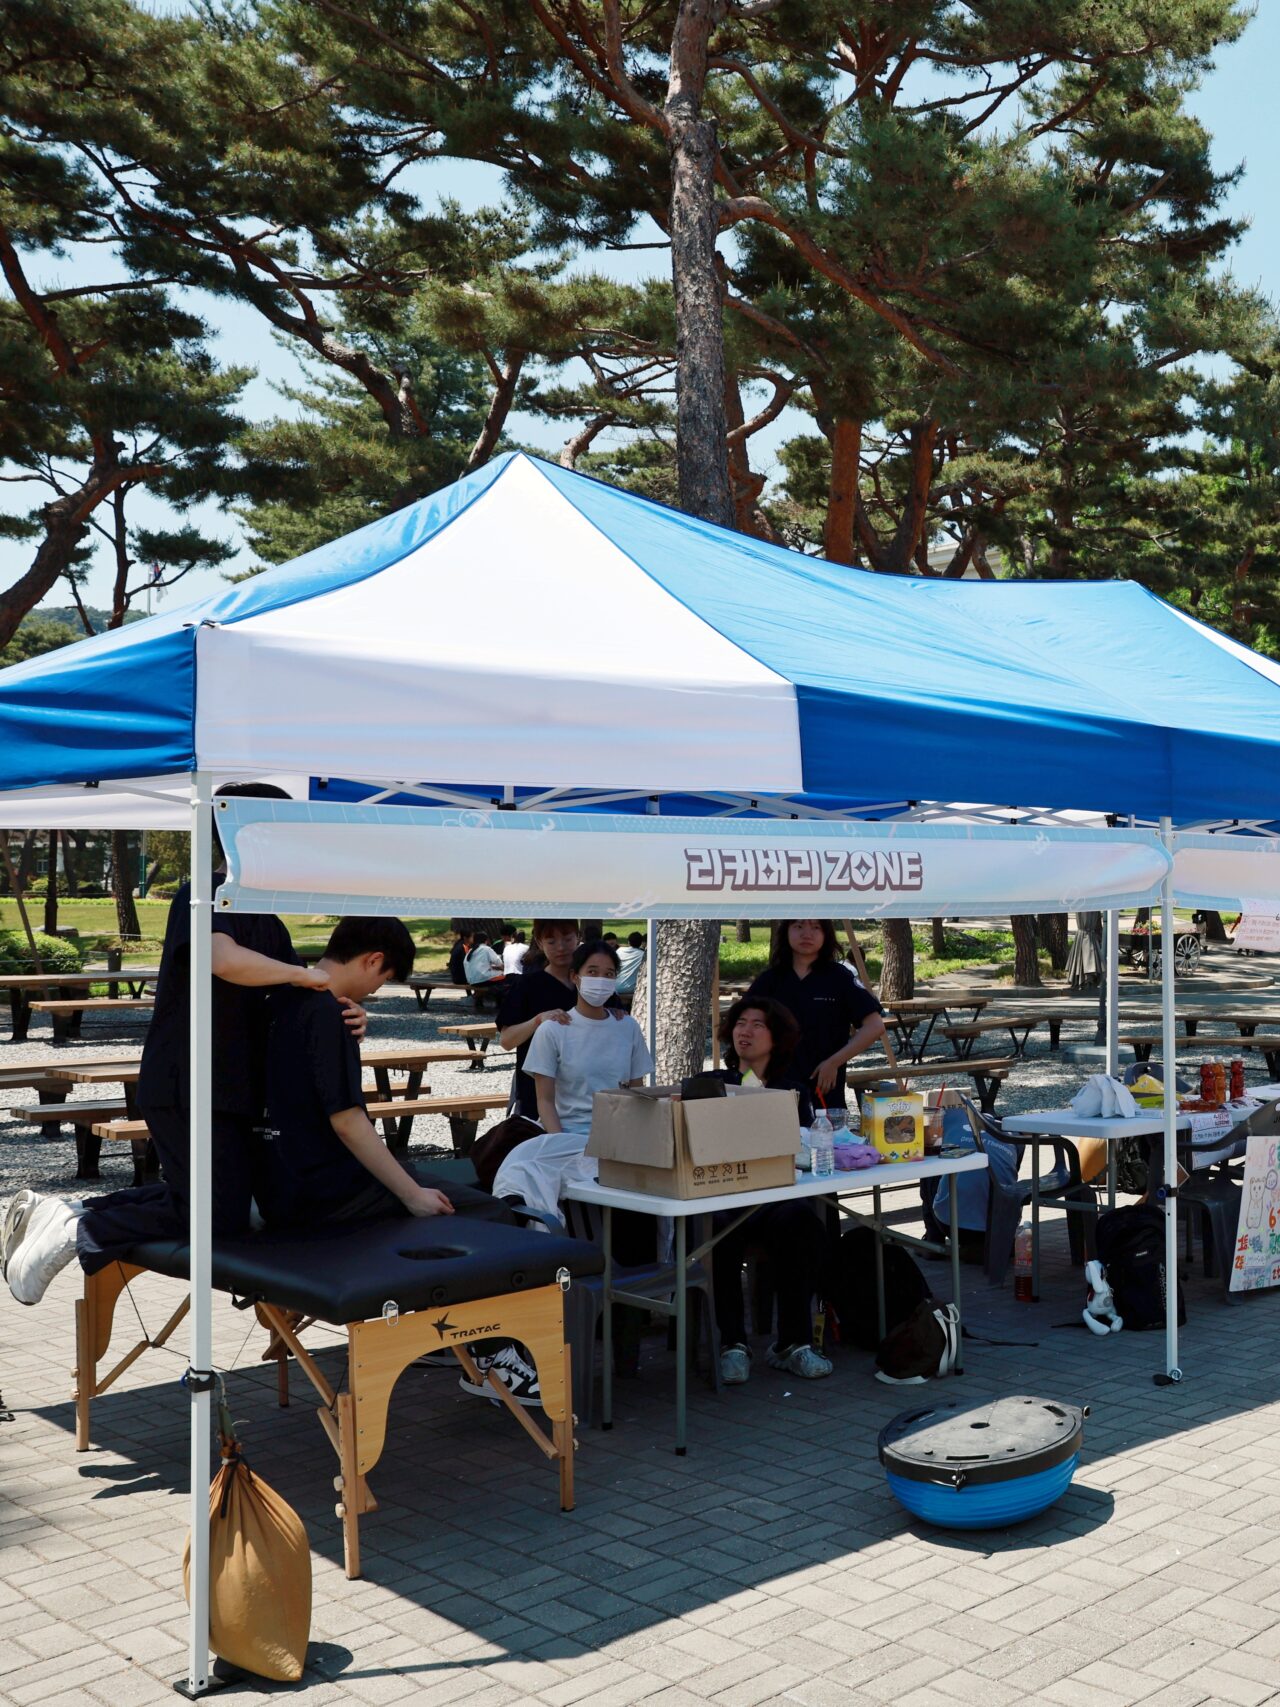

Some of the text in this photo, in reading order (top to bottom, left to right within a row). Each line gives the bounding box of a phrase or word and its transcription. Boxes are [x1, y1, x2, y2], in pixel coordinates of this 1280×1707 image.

[684, 848, 923, 891] 리커버리 ZONE
[450, 1323, 501, 1339] TRATAC
